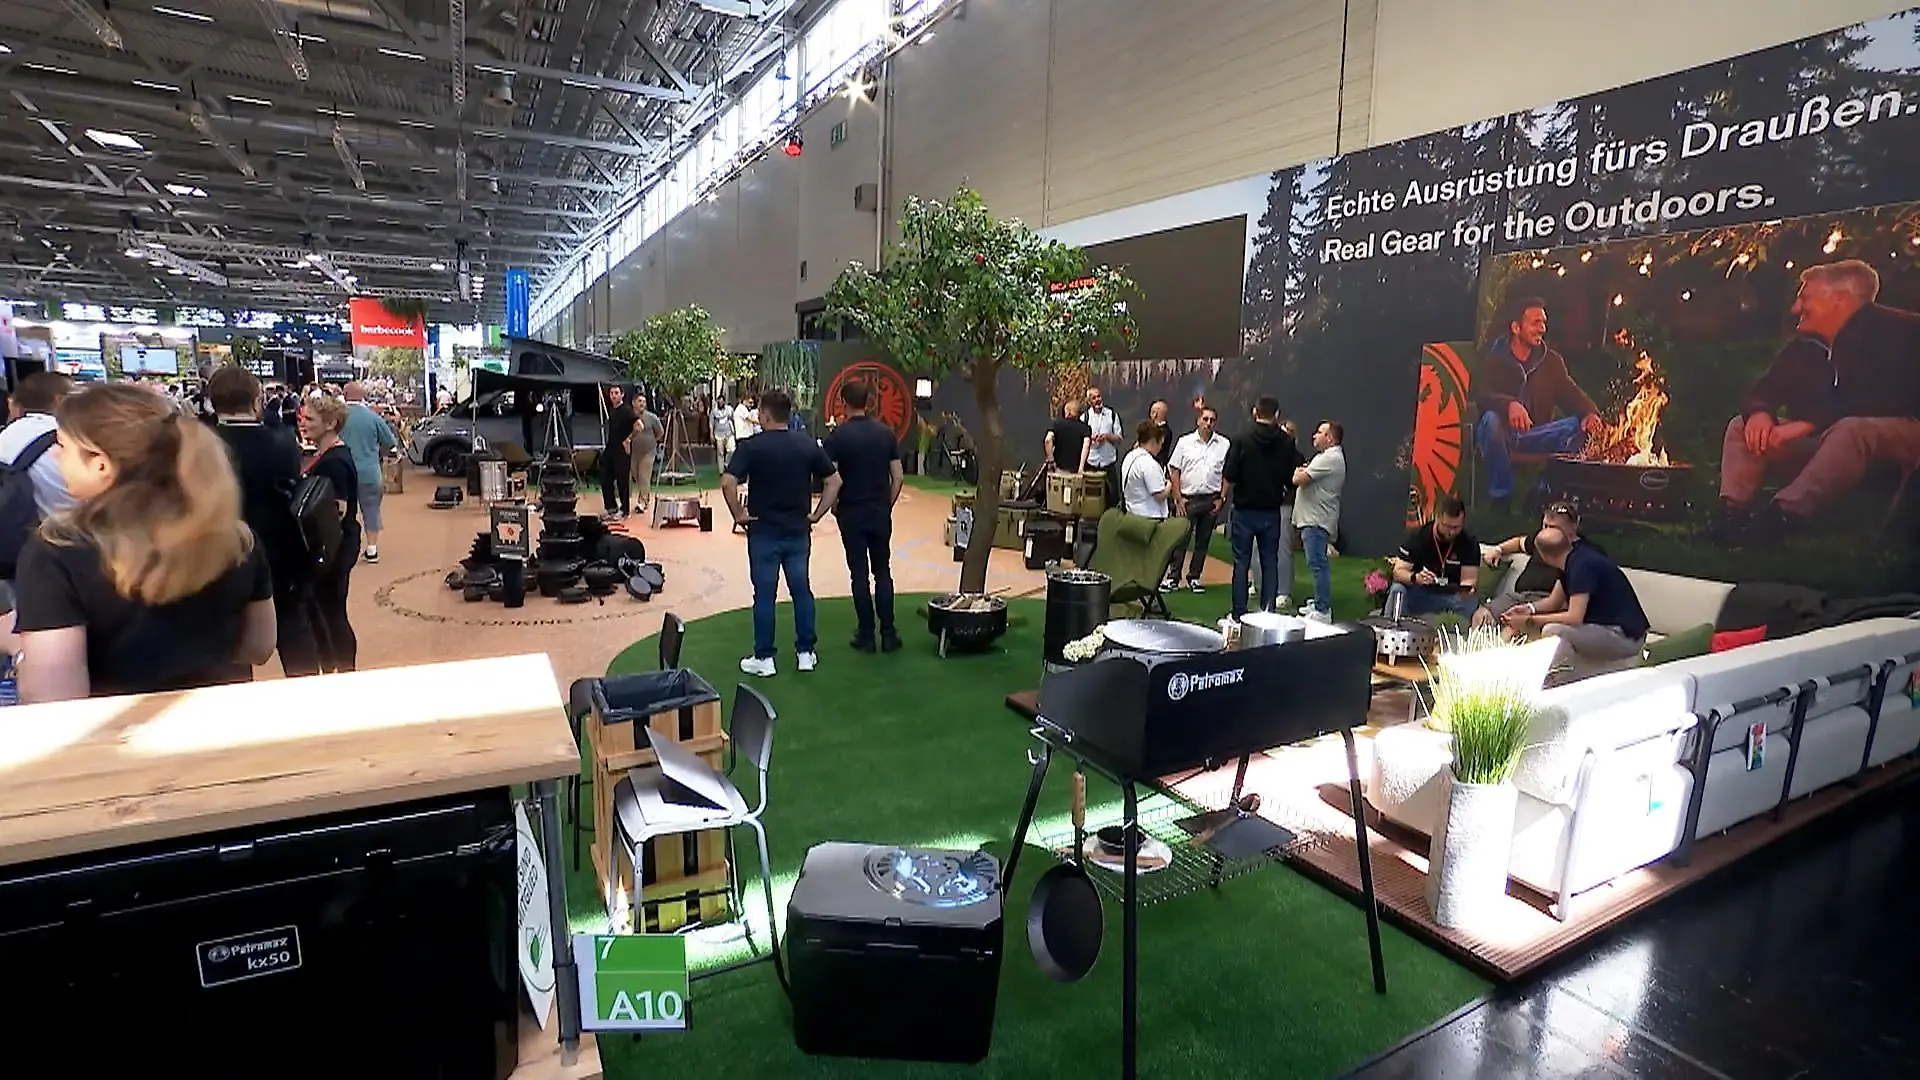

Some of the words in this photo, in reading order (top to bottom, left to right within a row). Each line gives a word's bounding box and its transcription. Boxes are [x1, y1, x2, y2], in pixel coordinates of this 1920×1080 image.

[1327, 189, 1395, 221] Echte
[1401, 156, 1578, 208] Ausrüstung
[1590, 139, 1668, 175] fürs
[1681, 91, 1919, 159] Draußen.
[1324, 233, 1375, 263] Real
[1381, 229, 1445, 256] Gear
[1452, 219, 1496, 247] for
[1503, 210, 1555, 241] the
[1565, 183, 1775, 233] Outdoors.
[360, 324, 415, 336] barbecook
[1190, 667, 1245, 692] Petromax
[230, 936, 289, 957] Petromax
[598, 937, 616, 960] 7
[246, 950, 291, 970] kx50
[608, 990, 683, 1021] A10
